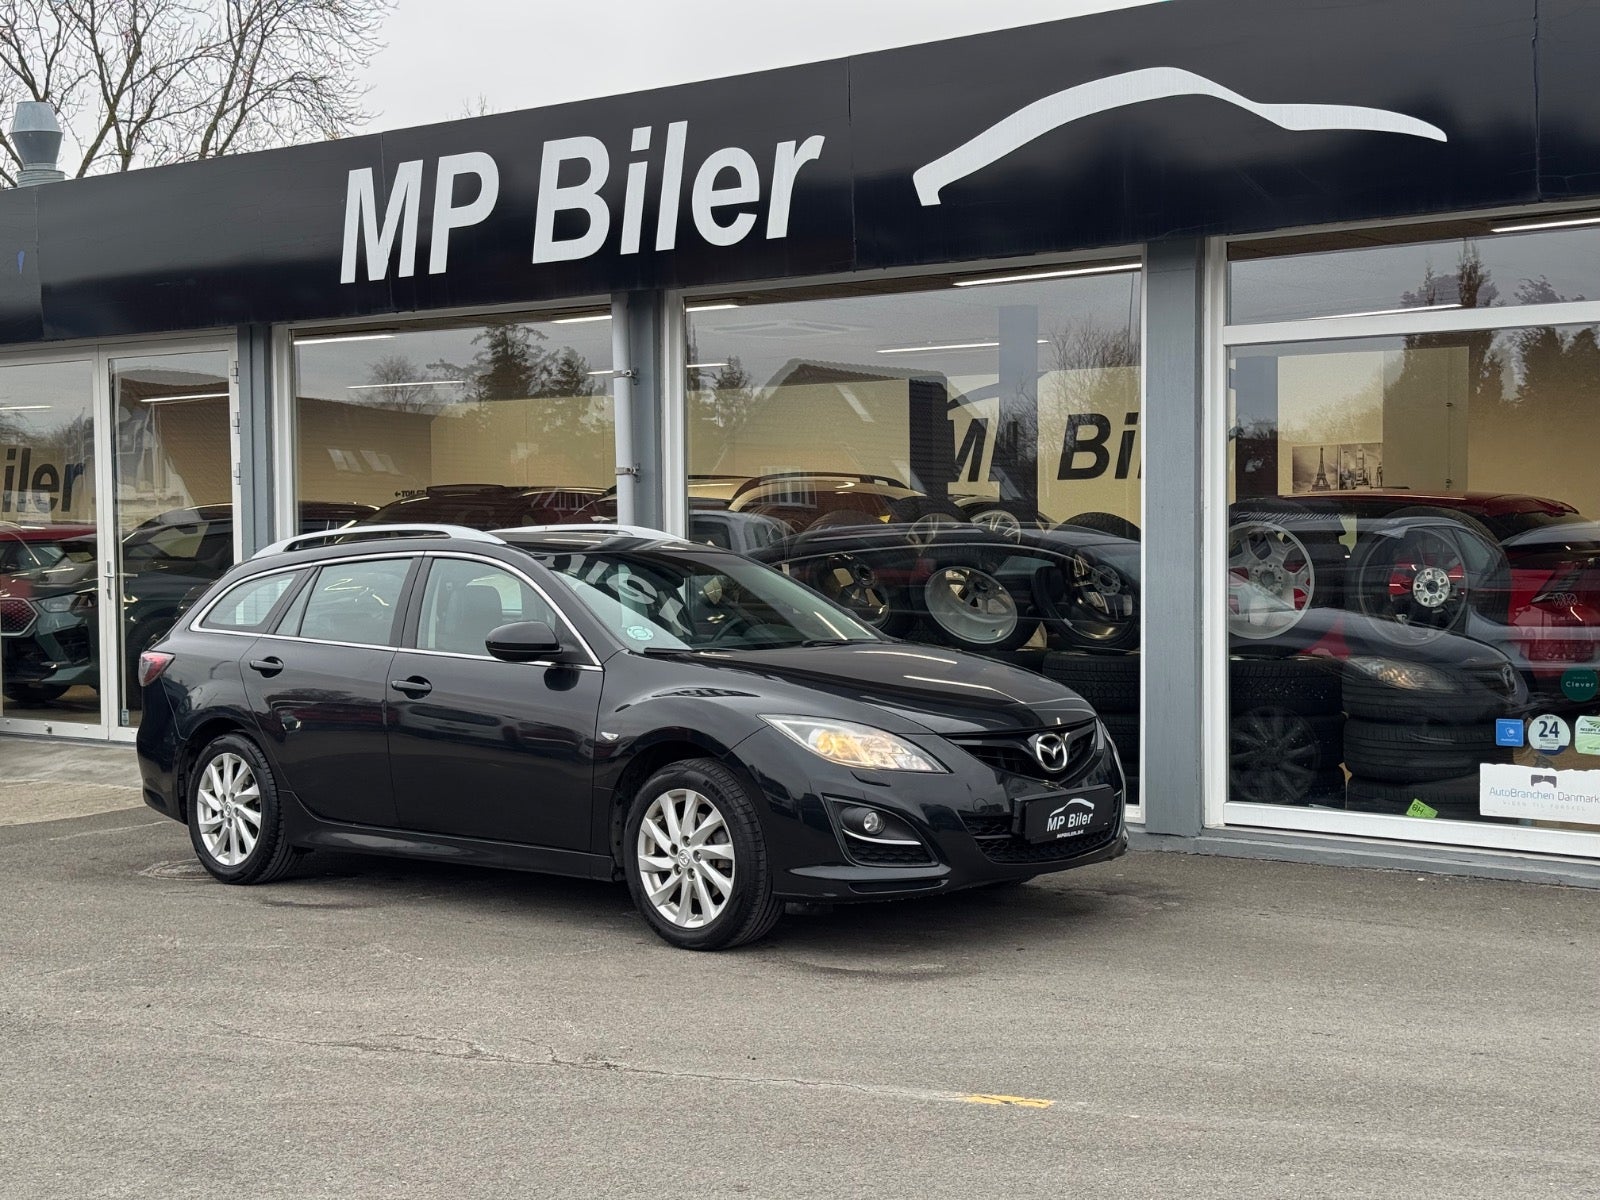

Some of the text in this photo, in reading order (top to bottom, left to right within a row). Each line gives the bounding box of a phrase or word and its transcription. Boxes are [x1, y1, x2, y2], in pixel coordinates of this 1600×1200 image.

[340, 120, 825, 284] MP Biler
[1057, 411, 1141, 481] Bi
[1538, 720, 1560, 738] 24
[1489, 787, 1600, 803] AutoBranchen Danmark
[1046, 812, 1093, 832] MP Biler
